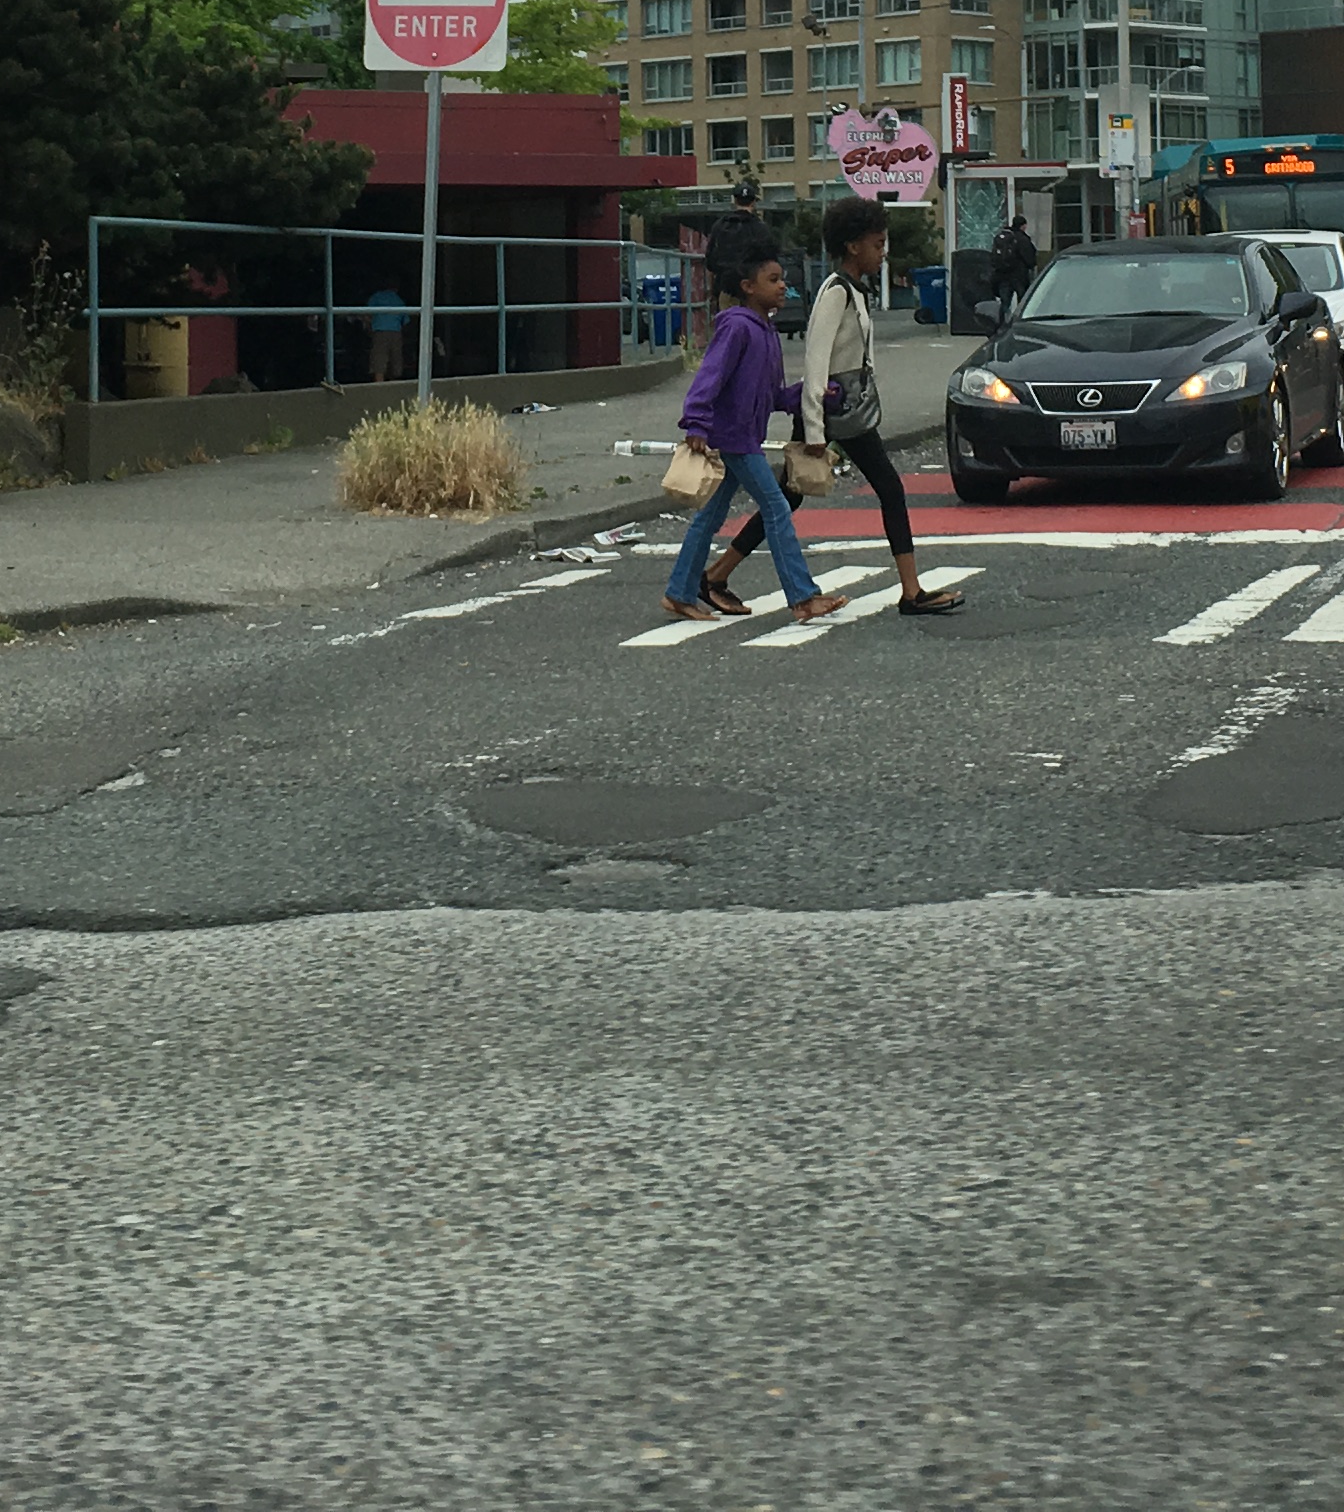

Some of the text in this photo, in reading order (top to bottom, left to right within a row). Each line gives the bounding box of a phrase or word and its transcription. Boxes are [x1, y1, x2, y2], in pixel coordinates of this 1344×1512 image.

[394, 15, 477, 38] ENTER
[846, 131, 899, 142] ELEPHT
[842, 144, 933, 175] Super
[1225, 158, 1235, 175] 5
[853, 171, 923, 184] CAR WASH
